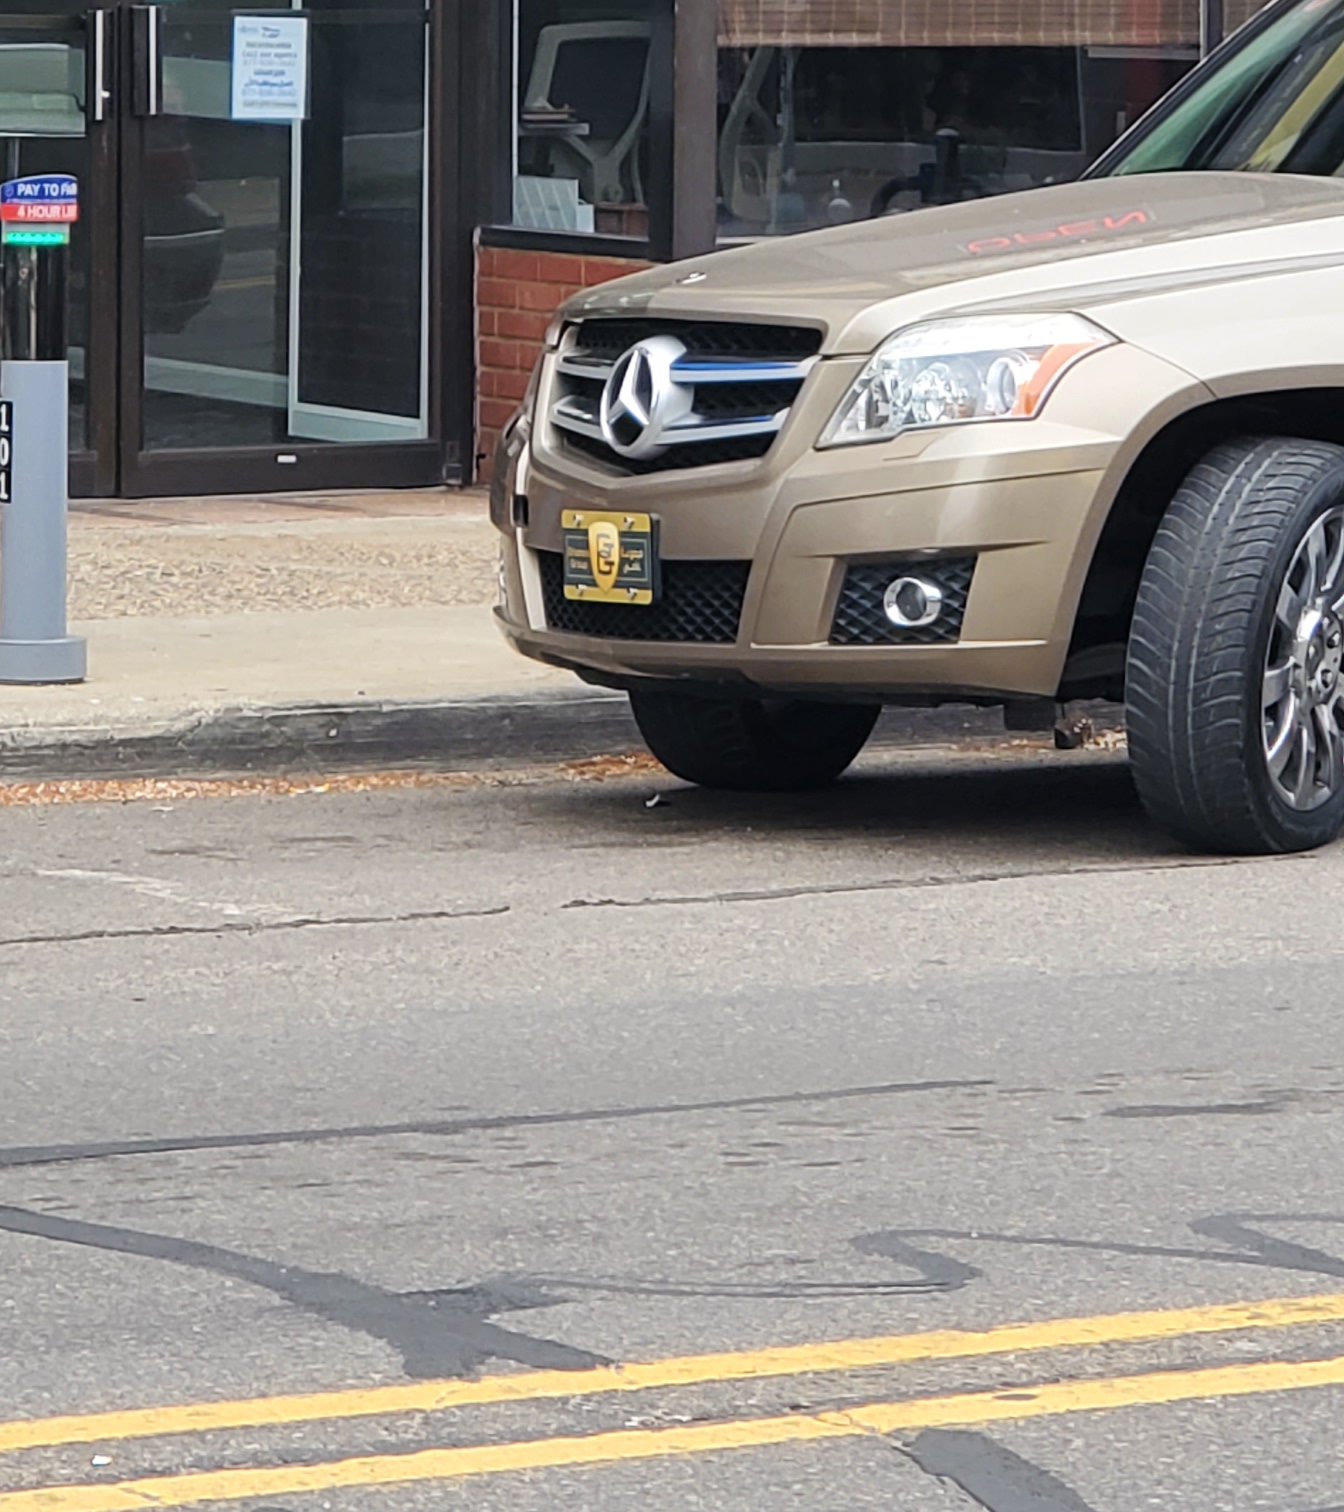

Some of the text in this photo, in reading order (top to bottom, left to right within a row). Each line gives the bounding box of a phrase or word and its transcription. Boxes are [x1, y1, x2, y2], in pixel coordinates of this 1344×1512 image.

[17, 183, 40, 197] PAY
[42, 183, 60, 197] TO
[27, 205, 61, 219] HOUR
[0, 403, 10, 501] 101
